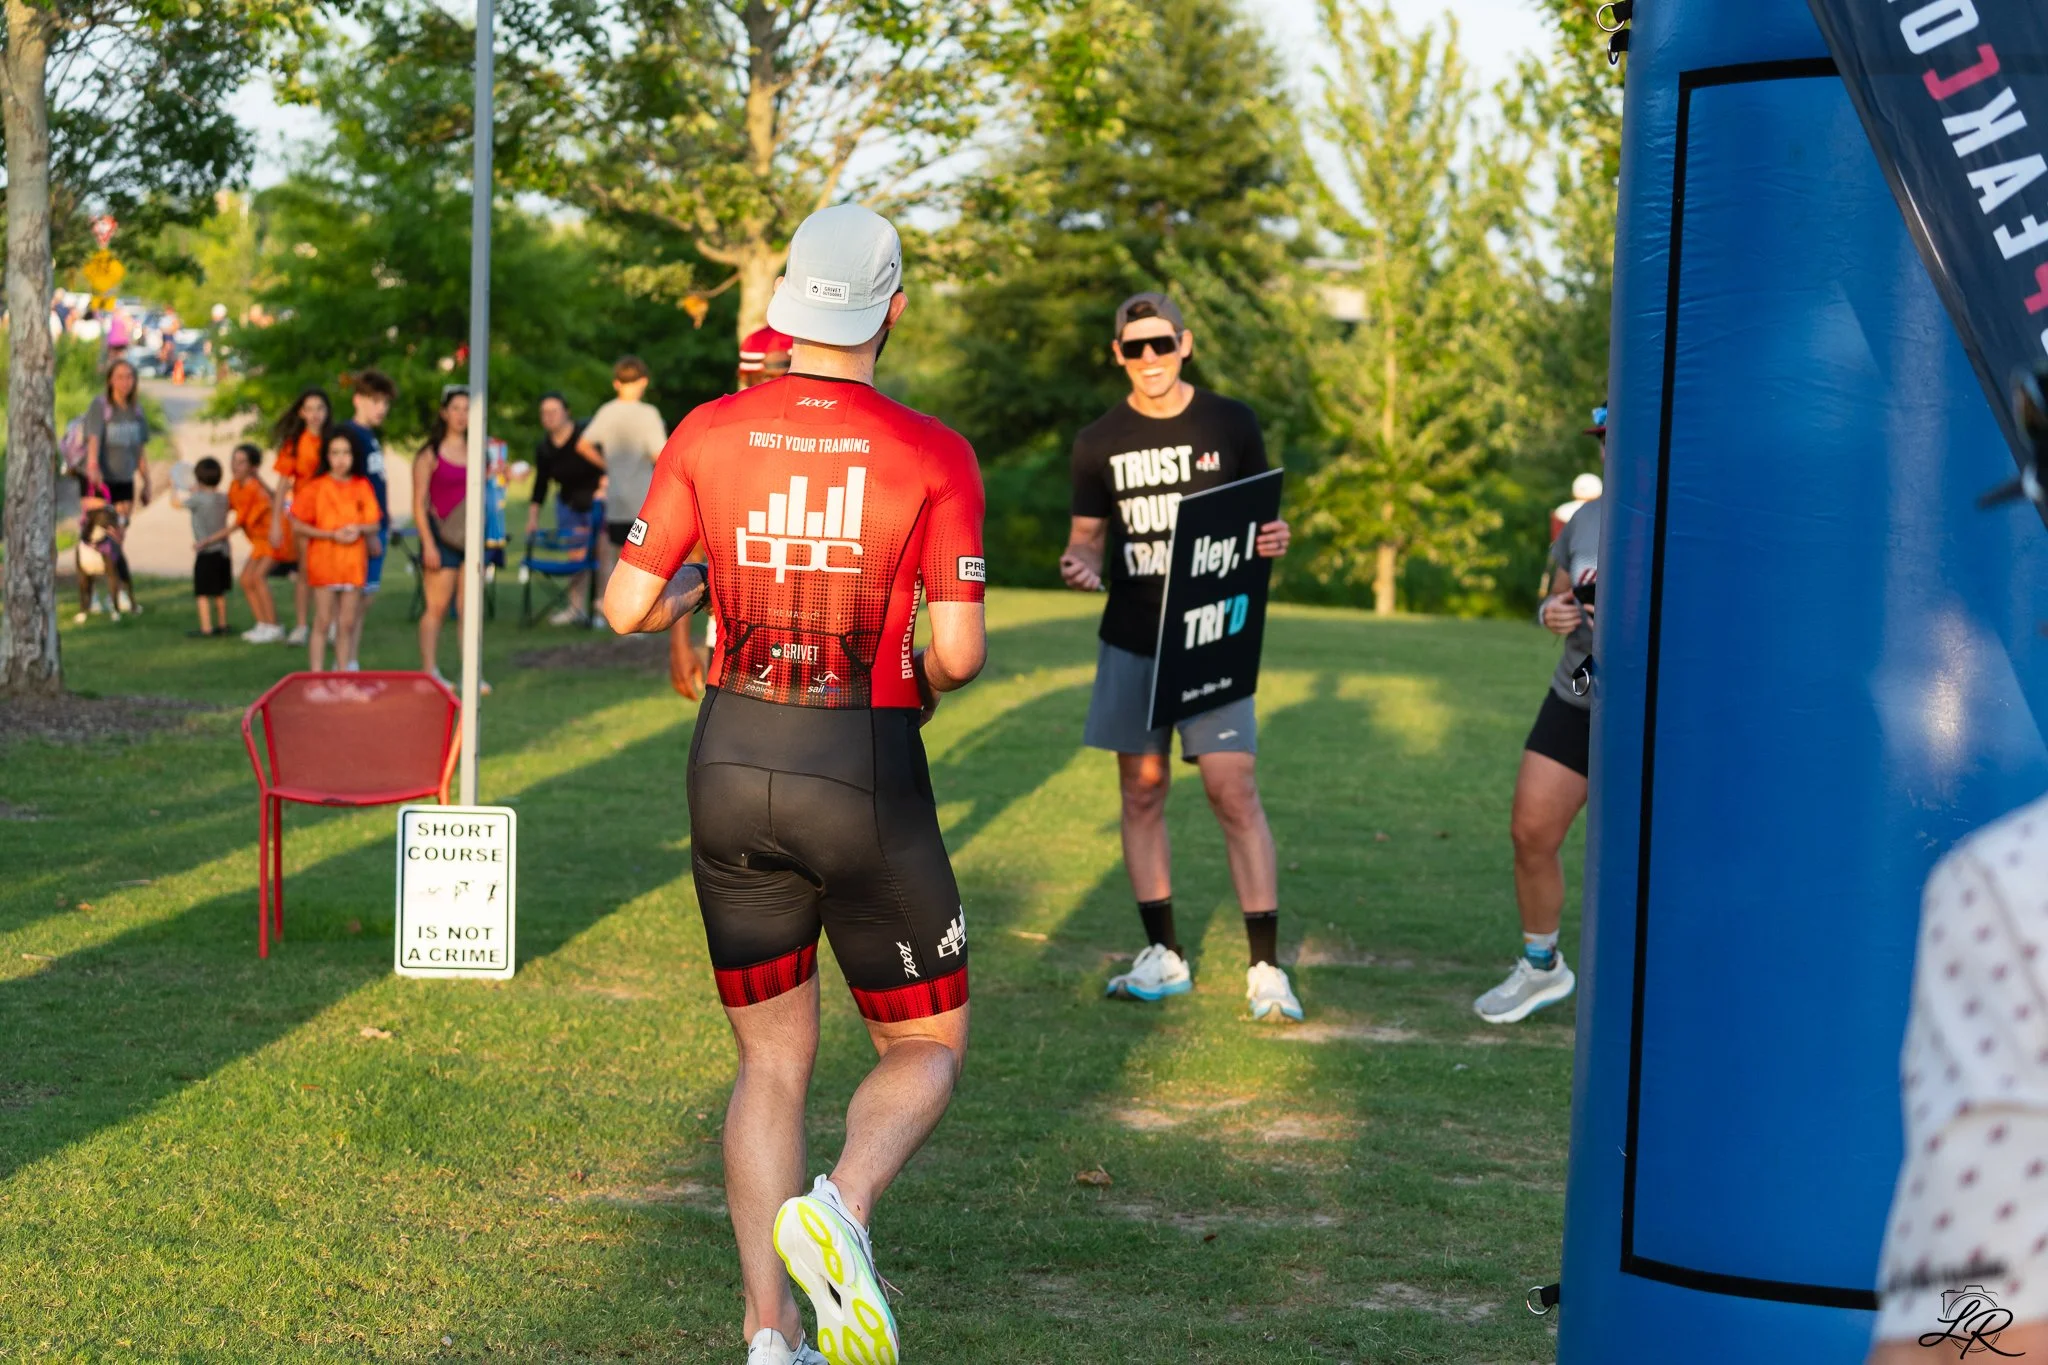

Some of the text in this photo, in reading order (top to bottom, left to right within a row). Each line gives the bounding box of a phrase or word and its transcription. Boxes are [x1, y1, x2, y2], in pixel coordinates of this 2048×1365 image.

[748, 431, 870, 454] TRUST YOUR TRAINING
[1109, 445, 1193, 491] TRUST
[1191, 521, 1257, 578] Hey, I
[783, 643, 819, 661] GRIVET
[417, 822, 497, 838] SHORT
[407, 846, 503, 862] COURSE
[417, 925, 494, 940] IS NOT
[407, 947, 500, 963] A CRIME
